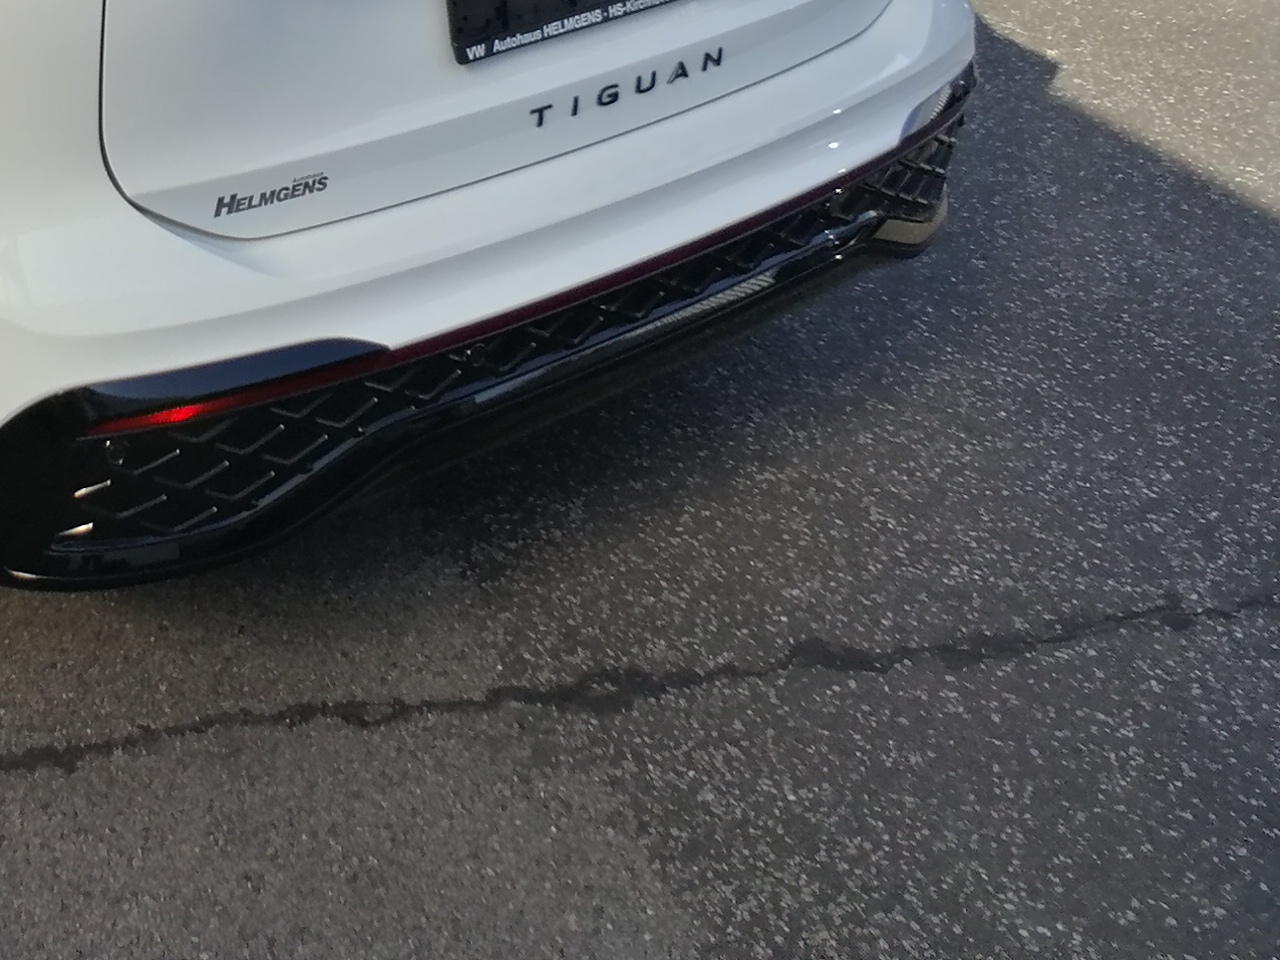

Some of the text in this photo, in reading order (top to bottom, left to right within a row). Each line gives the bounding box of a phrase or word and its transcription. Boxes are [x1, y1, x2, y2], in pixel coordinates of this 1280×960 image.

[466, 43, 486, 61] VW
[491, 29, 543, 54] Autohaus
[543, 7, 603, 38] HELMGENS
[528, 45, 725, 129] TIGUAN
[213, 176, 329, 218] HELMGENS
